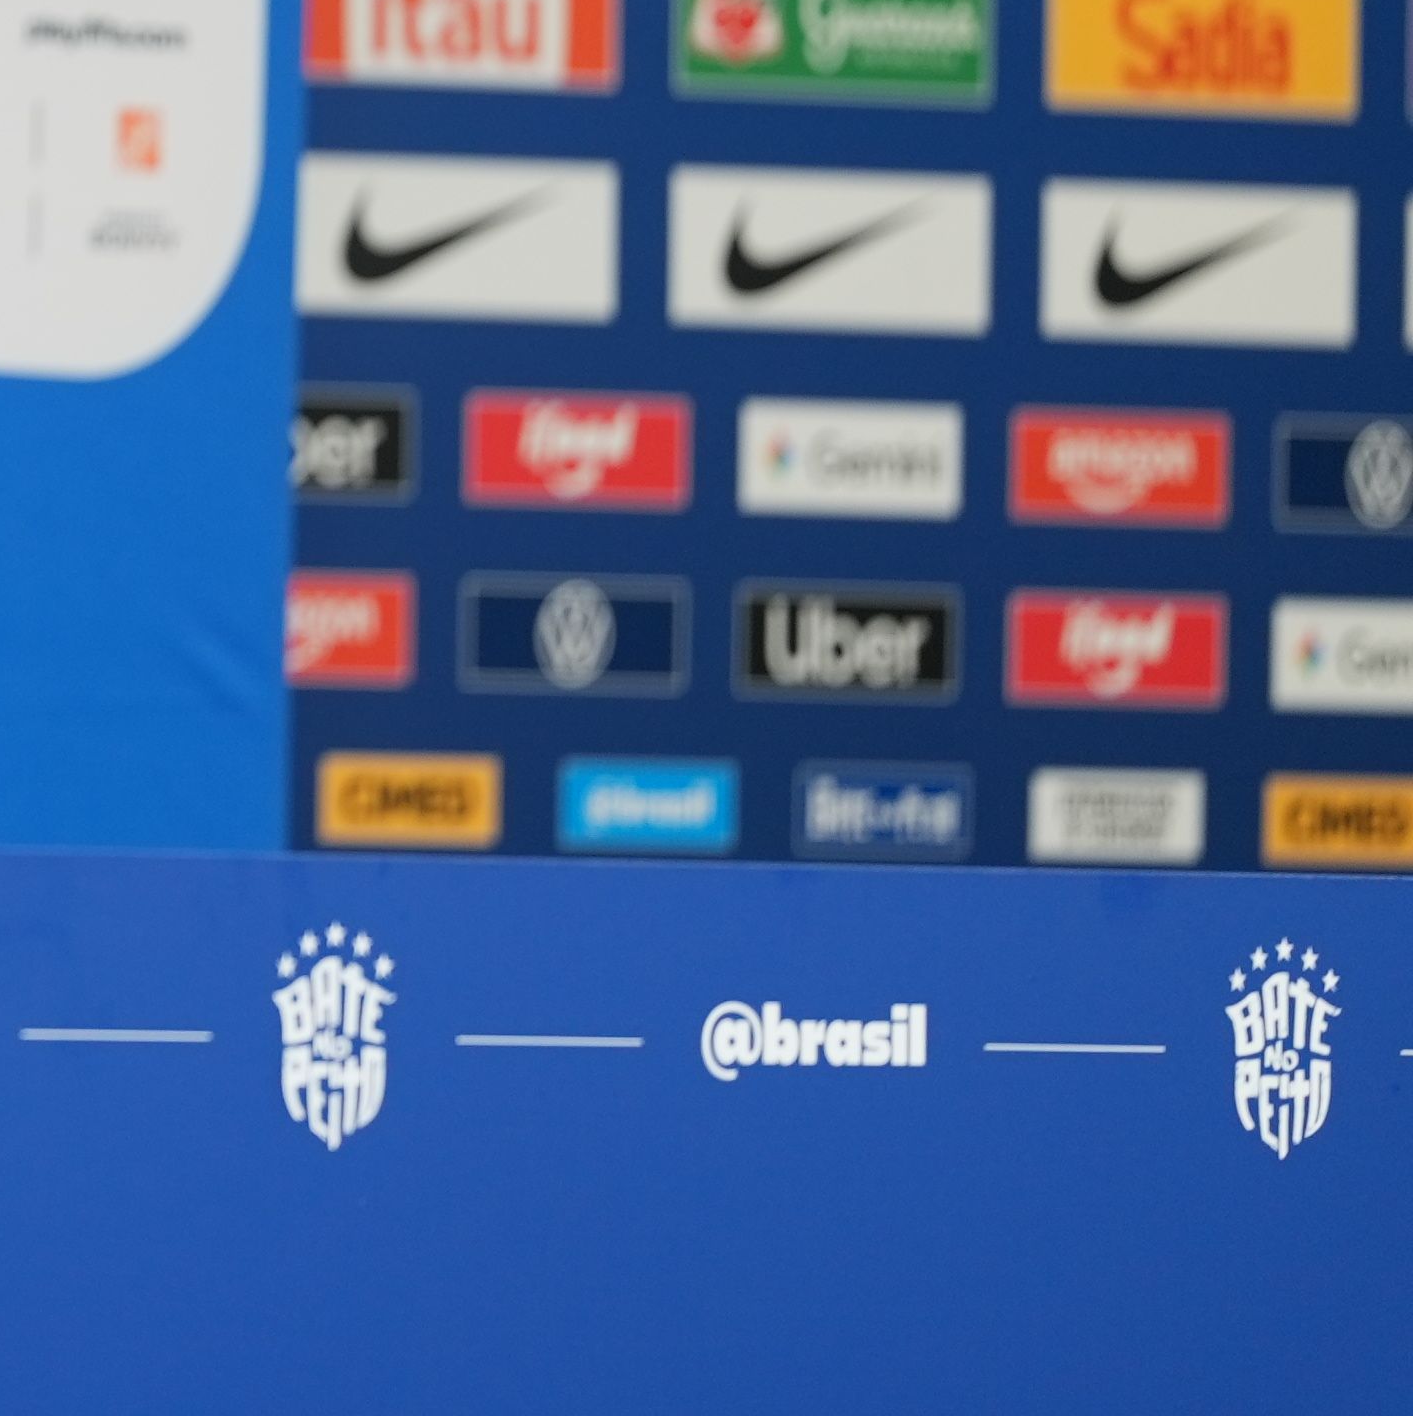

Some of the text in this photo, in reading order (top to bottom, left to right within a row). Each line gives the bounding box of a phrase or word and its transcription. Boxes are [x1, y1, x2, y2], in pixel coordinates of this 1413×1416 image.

[763, 602, 938, 685] Uber
[271, 954, 399, 1046] BATE
[701, 1001, 927, 1081] @brasil
[1224, 970, 1343, 1057] BATE
[1263, 1040, 1300, 1073] NO
[1233, 1057, 1332, 1162] PEITO
